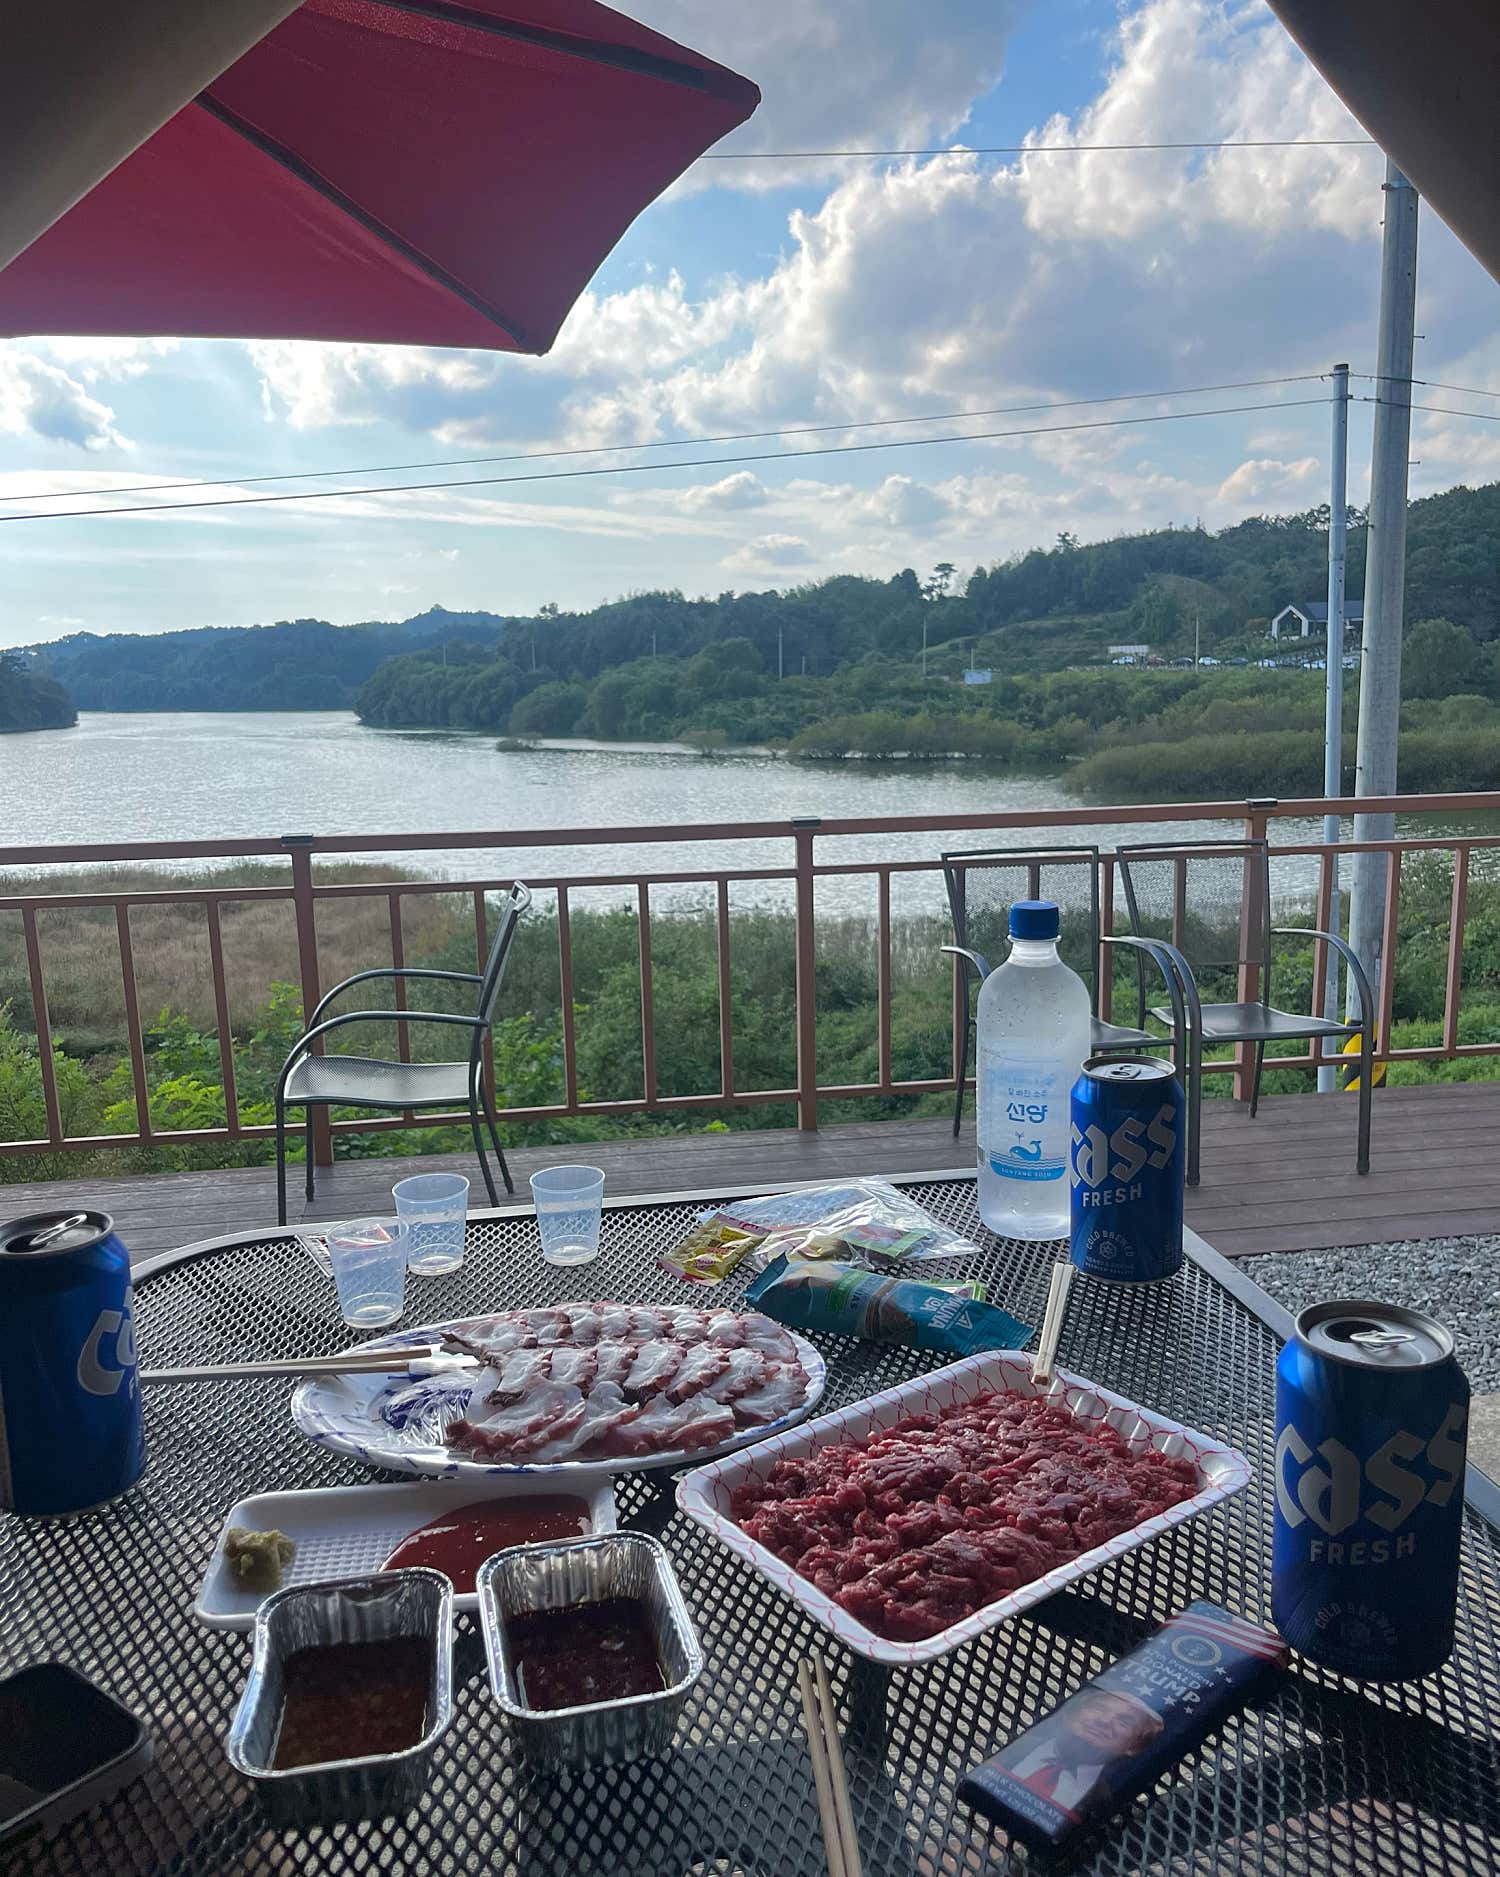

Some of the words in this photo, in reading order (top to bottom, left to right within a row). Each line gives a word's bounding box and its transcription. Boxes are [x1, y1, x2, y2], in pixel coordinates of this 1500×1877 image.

[1006, 1102, 1049, 1124] 선양
[1082, 1181, 1143, 1208] FRESH
[920, 1296, 945, 1312] LOA
[927, 1293, 968, 1329] MAUNA
[1309, 1532, 1417, 1565] FRESH
[1120, 1659, 1202, 1704] TRUMP
[1141, 1656, 1202, 1690] DONALD
